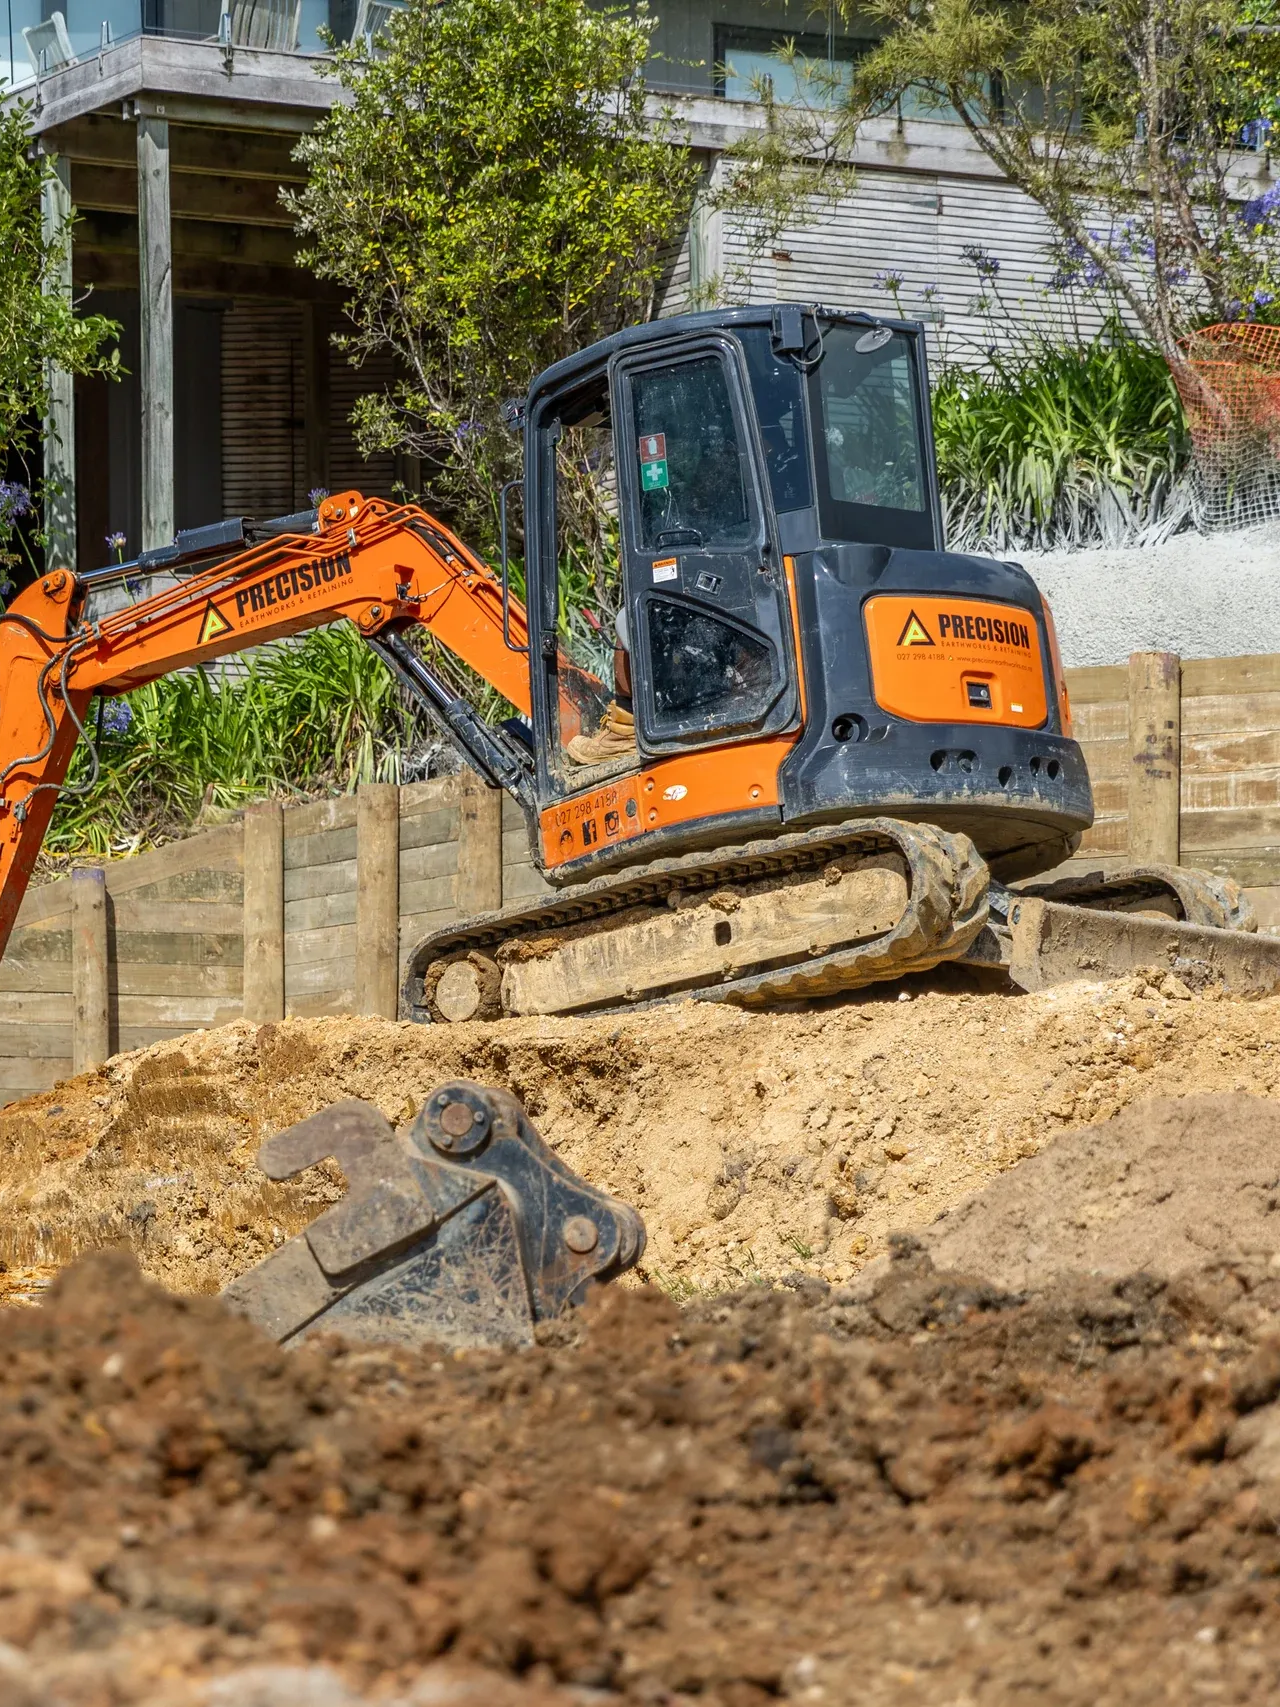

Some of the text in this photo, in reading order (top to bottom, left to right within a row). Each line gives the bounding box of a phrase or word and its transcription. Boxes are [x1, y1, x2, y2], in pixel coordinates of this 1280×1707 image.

[234, 549, 352, 618] PRECISION
[239, 601, 296, 628] EARTHWORKS
[307, 576, 354, 600] RETAINING
[938, 613, 1030, 649] PRECISION
[896, 653, 945, 661] 027 298 4188
[941, 641, 991, 651] EARTHWORKS
[1000, 646, 1032, 659] RETAINING
[555, 808, 571, 827] 027
[575, 800, 592, 819] 298
